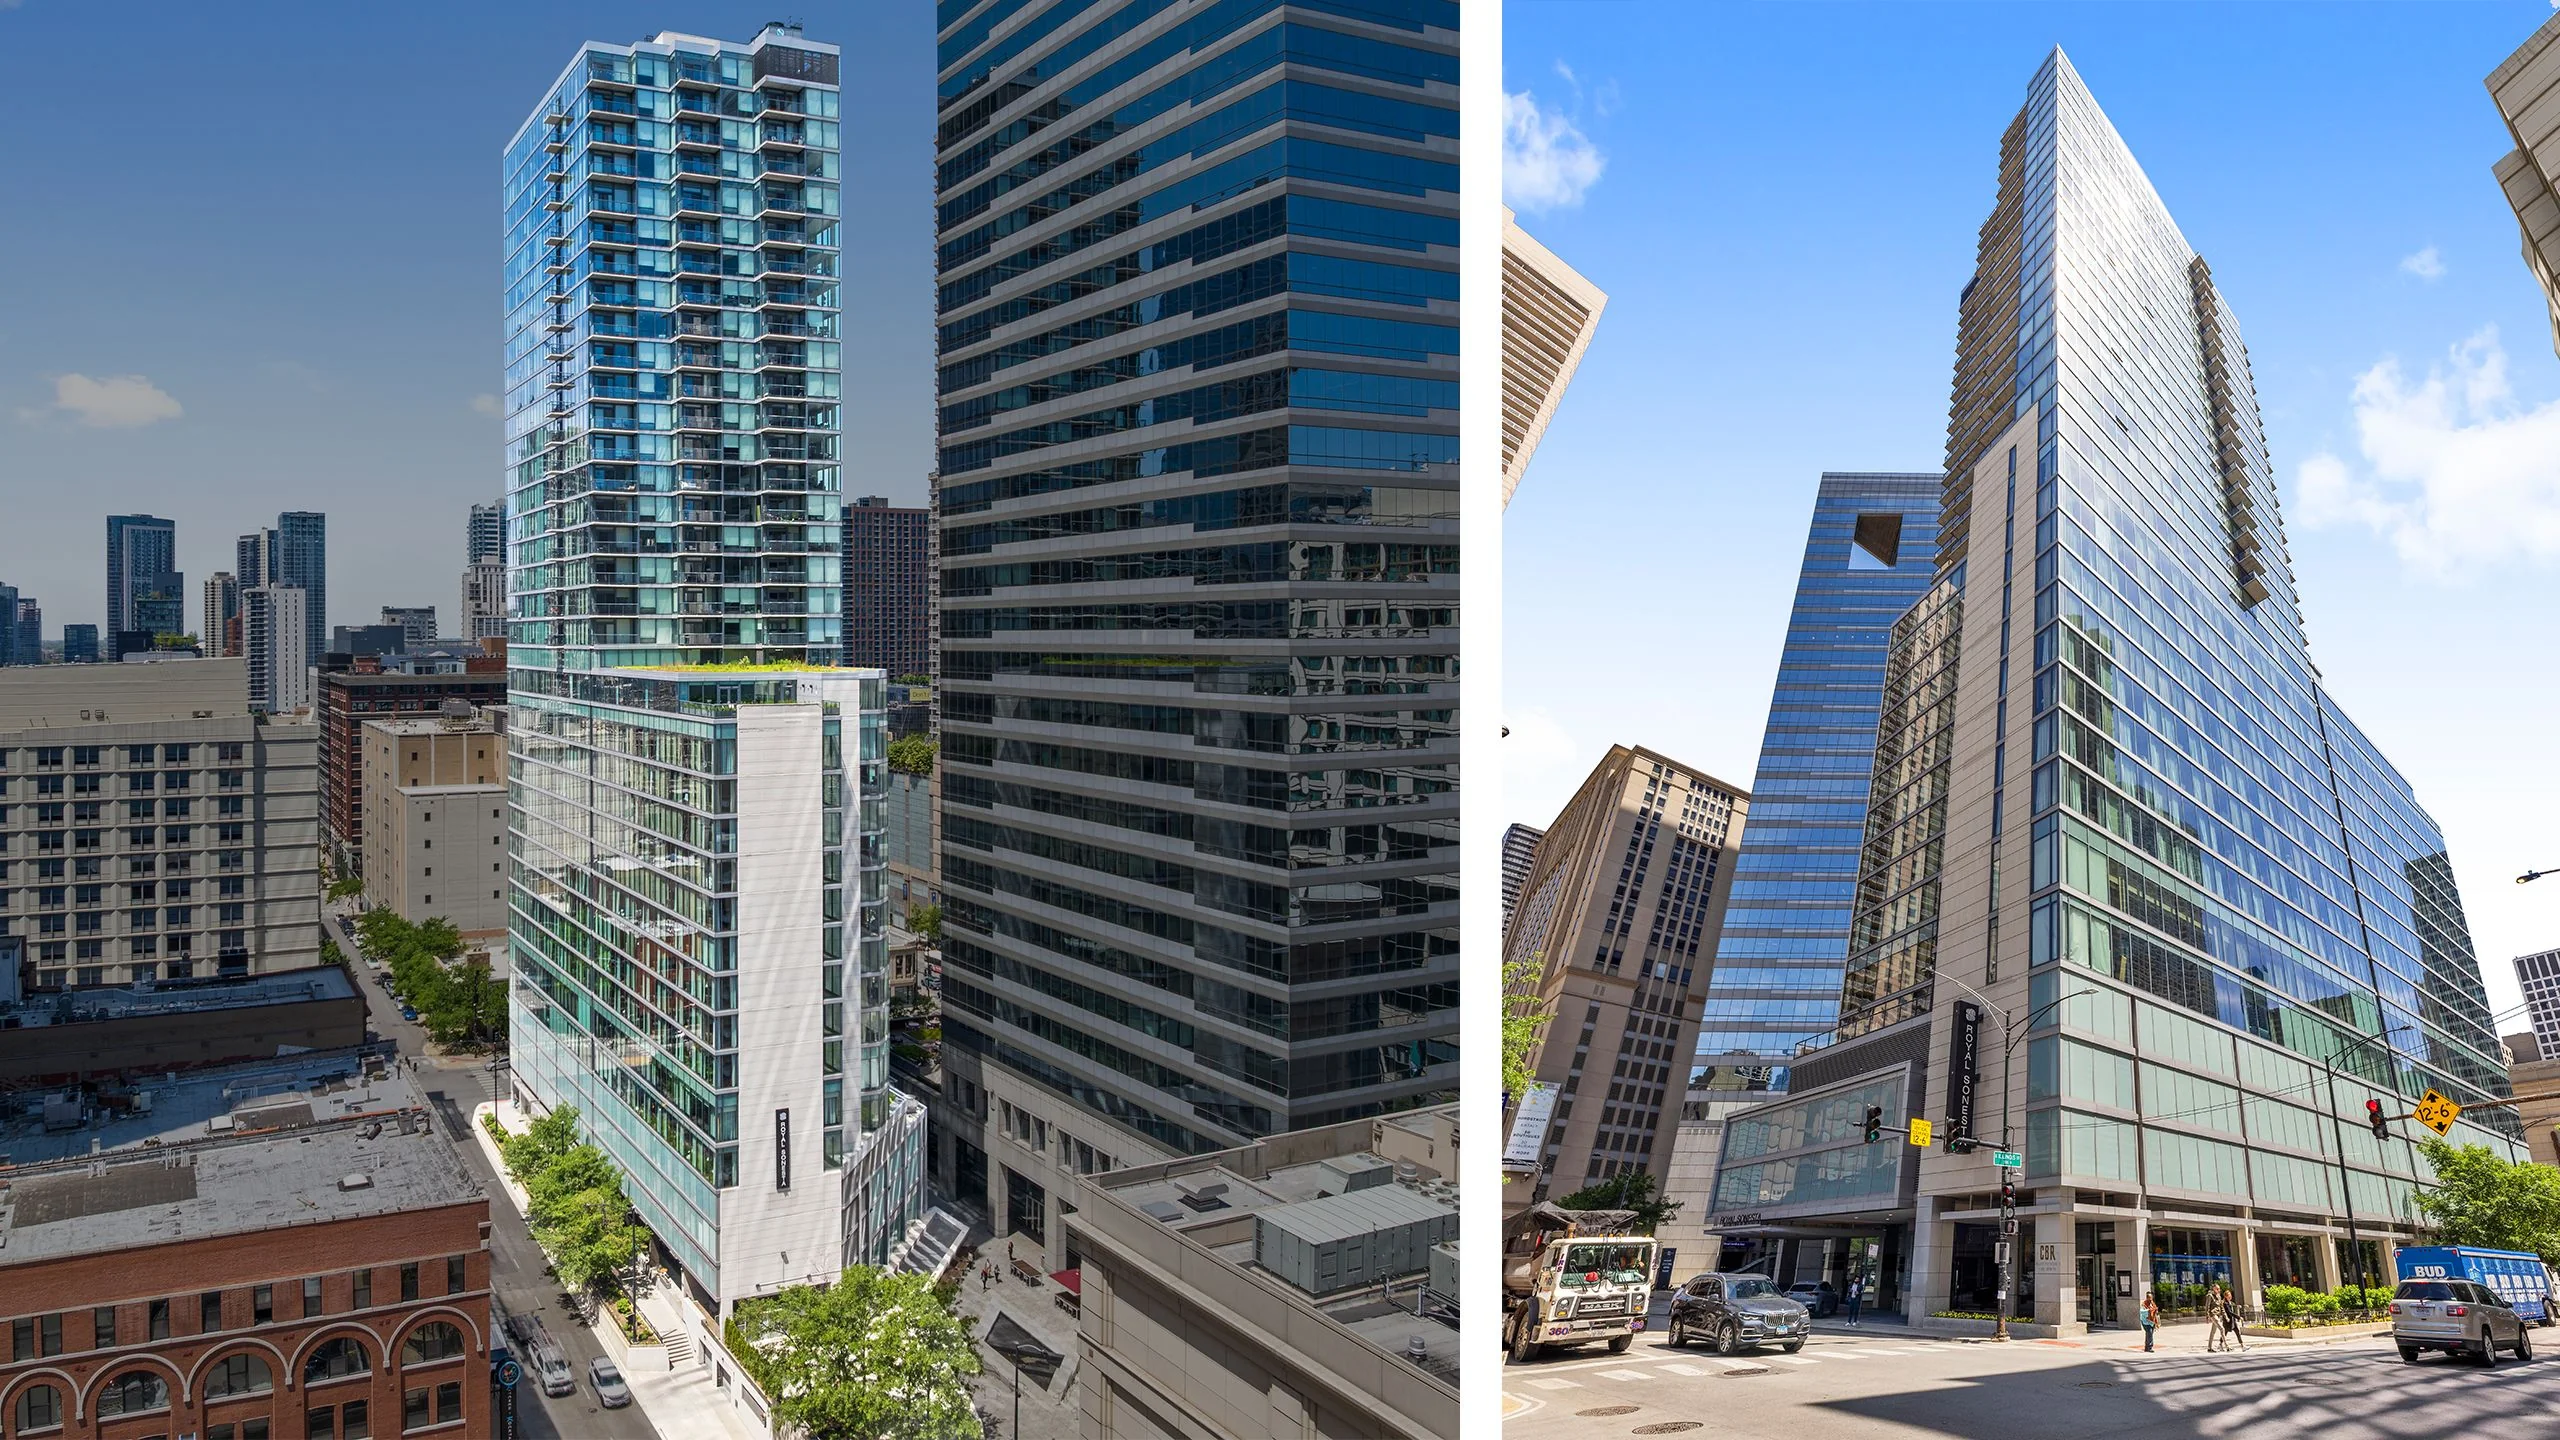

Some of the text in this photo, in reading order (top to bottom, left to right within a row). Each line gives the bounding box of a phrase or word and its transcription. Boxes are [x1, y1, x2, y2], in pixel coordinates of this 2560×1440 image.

[1964, 1024, 1973, 1070] ROYAL
[2414, 1265, 2446, 1277] BUD
[1549, 1327, 1568, 1336] 360
